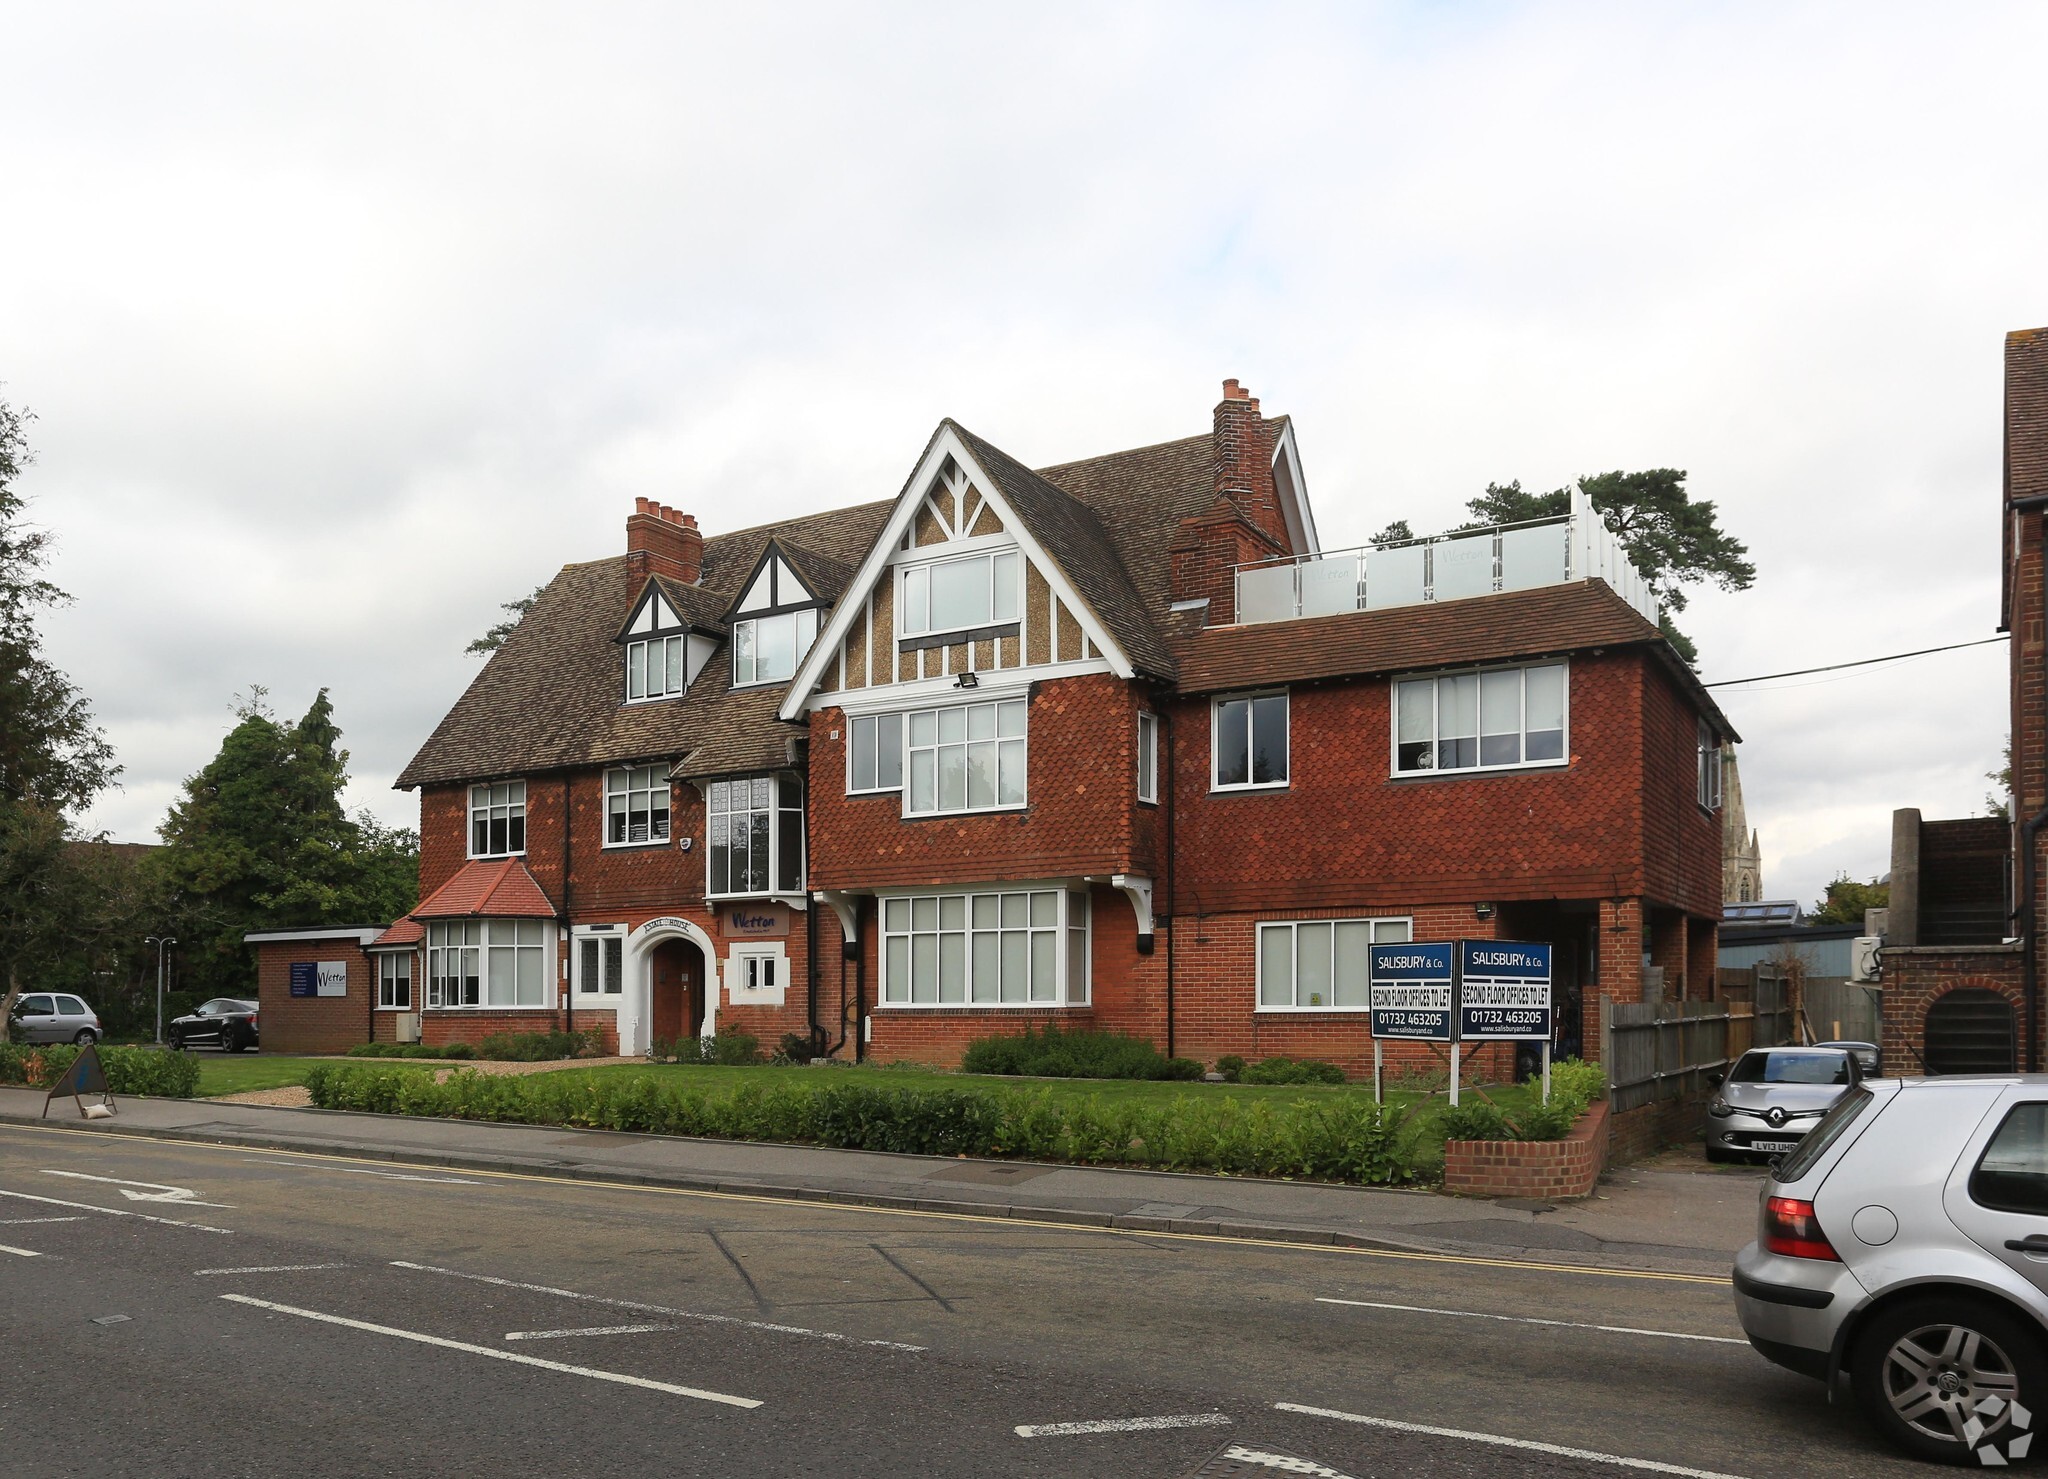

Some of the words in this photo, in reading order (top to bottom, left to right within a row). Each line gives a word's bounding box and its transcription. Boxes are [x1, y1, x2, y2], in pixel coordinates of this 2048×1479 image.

[732, 909, 775, 928] Wetton
[1378, 955, 1426, 969] SALISBURY
[1426, 959, 1432, 968] &
[1433, 958, 1444, 968] Co.
[1472, 952, 1525, 966] SALISBURY
[1525, 957, 1531, 967] &
[1533, 957, 1543, 967] Co.
[317, 968, 346, 987] Wetton
[1372, 989, 1391, 1007] SECOND
[1391, 989, 1408, 1007] FLOOR
[1408, 989, 1430, 1007] OFFICES
[1430, 989, 1439, 1007] TO
[1439, 989, 1450, 1007] LET
[1462, 986, 1486, 1004] SECOND
[1486, 986, 1506, 1004] FLOOR
[1506, 986, 1529, 1005] OFFICES
[1529, 987, 1538, 1005] TO
[1538, 987, 1548, 1005] LET
[1379, 1012, 1406, 1025] 01732
[1408, 1013, 1442, 1026] 463205
[1470, 1010, 1503, 1023] 01732
[1505, 1011, 1542, 1024] 463205
[1387, 1026, 1433, 1035] www.salisburyand.co
[1480, 1025, 1532, 1033] www.salisburyand.co
[1756, 1142, 1776, 1151] LV13
